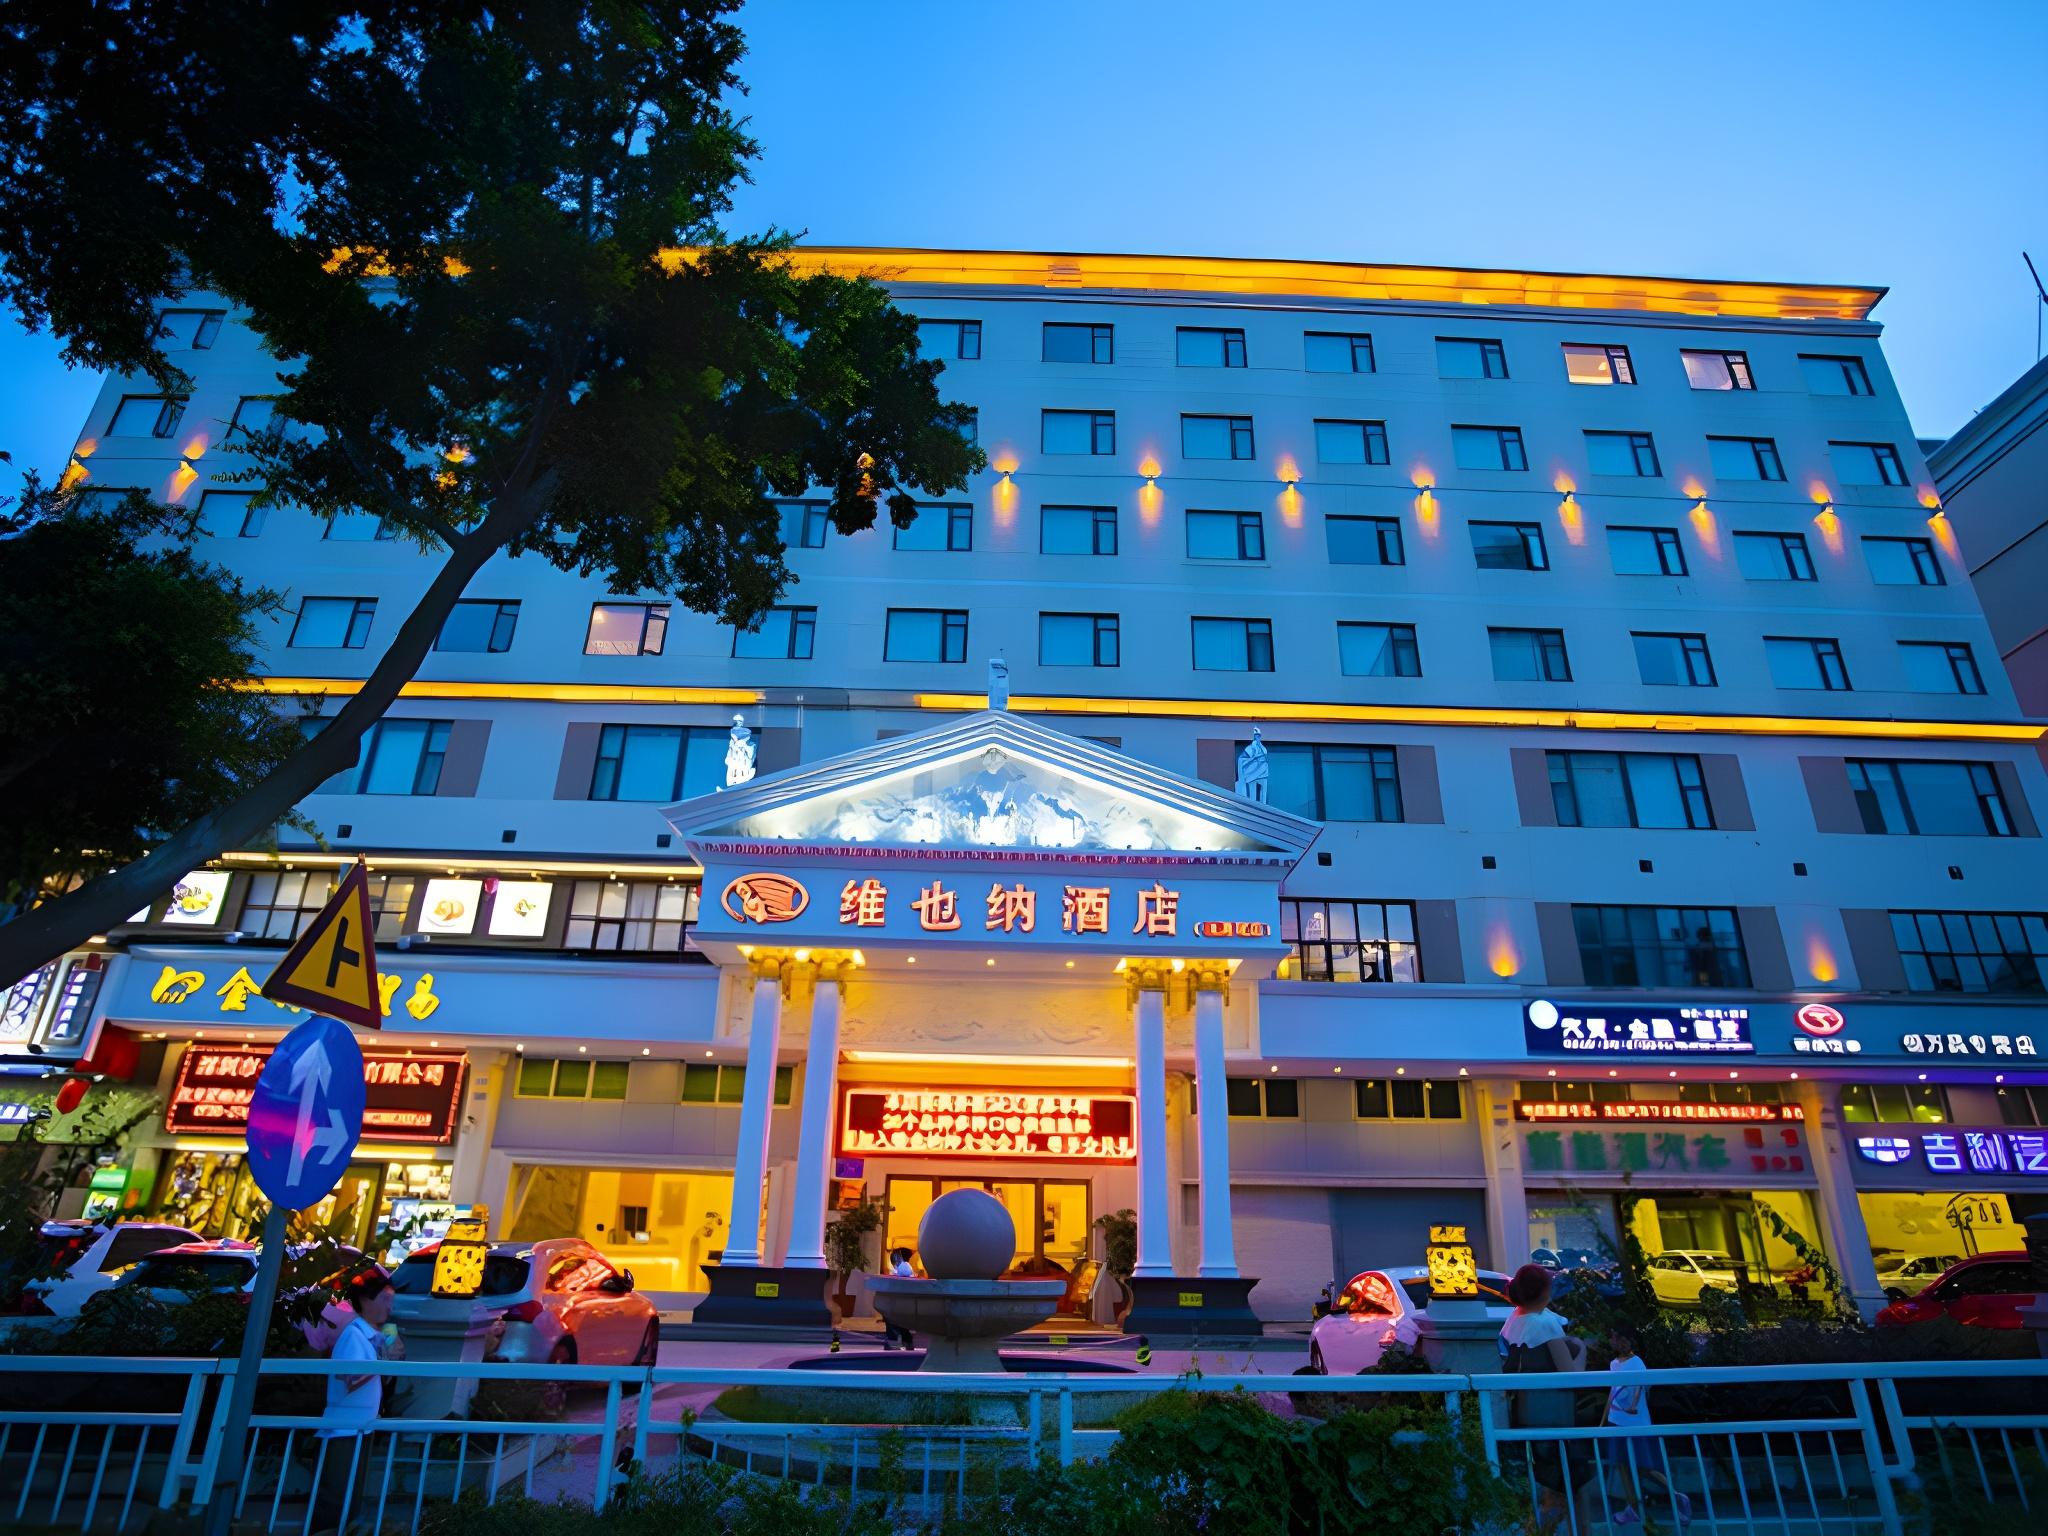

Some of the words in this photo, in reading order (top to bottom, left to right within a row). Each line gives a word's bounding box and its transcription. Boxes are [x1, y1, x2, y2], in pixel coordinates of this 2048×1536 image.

[840, 879, 1181, 936] 维也纳酒店
